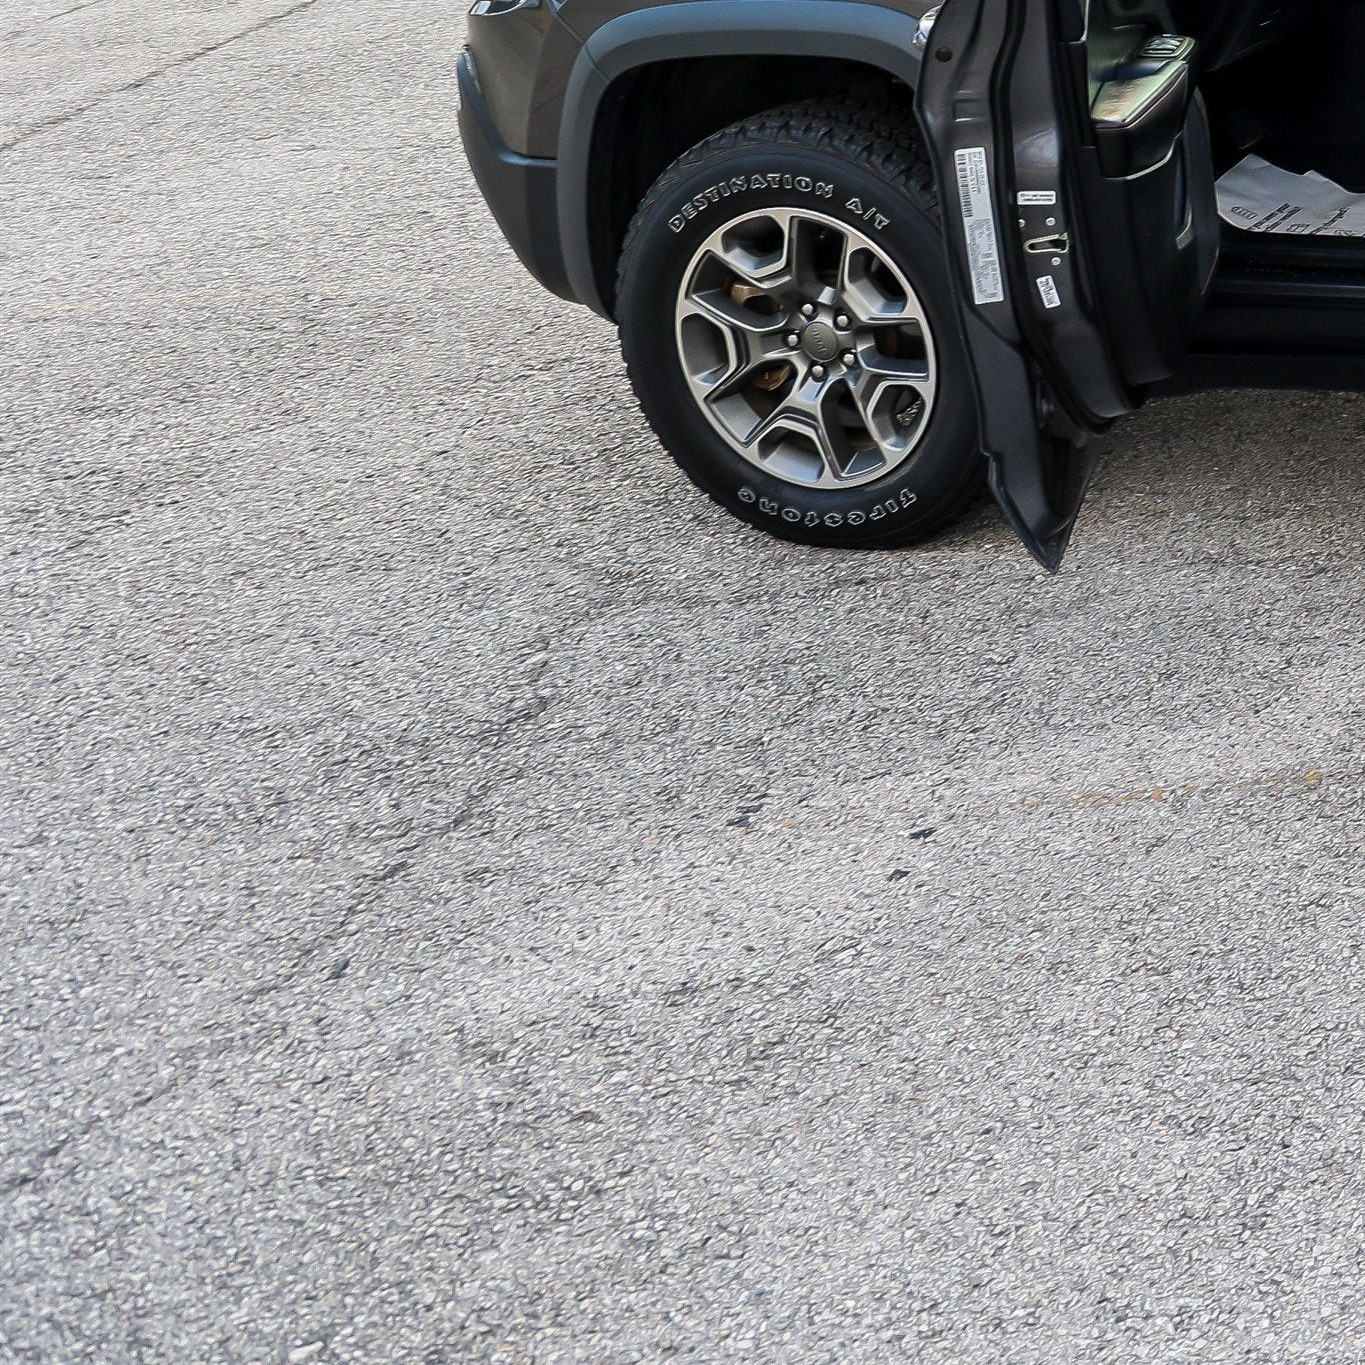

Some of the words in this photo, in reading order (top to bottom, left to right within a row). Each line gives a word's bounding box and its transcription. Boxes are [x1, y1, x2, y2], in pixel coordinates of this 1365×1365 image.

[667, 173, 834, 233] DESTINATION
[845, 197, 891, 230] A/T
[737, 487, 917, 528] Firestone
